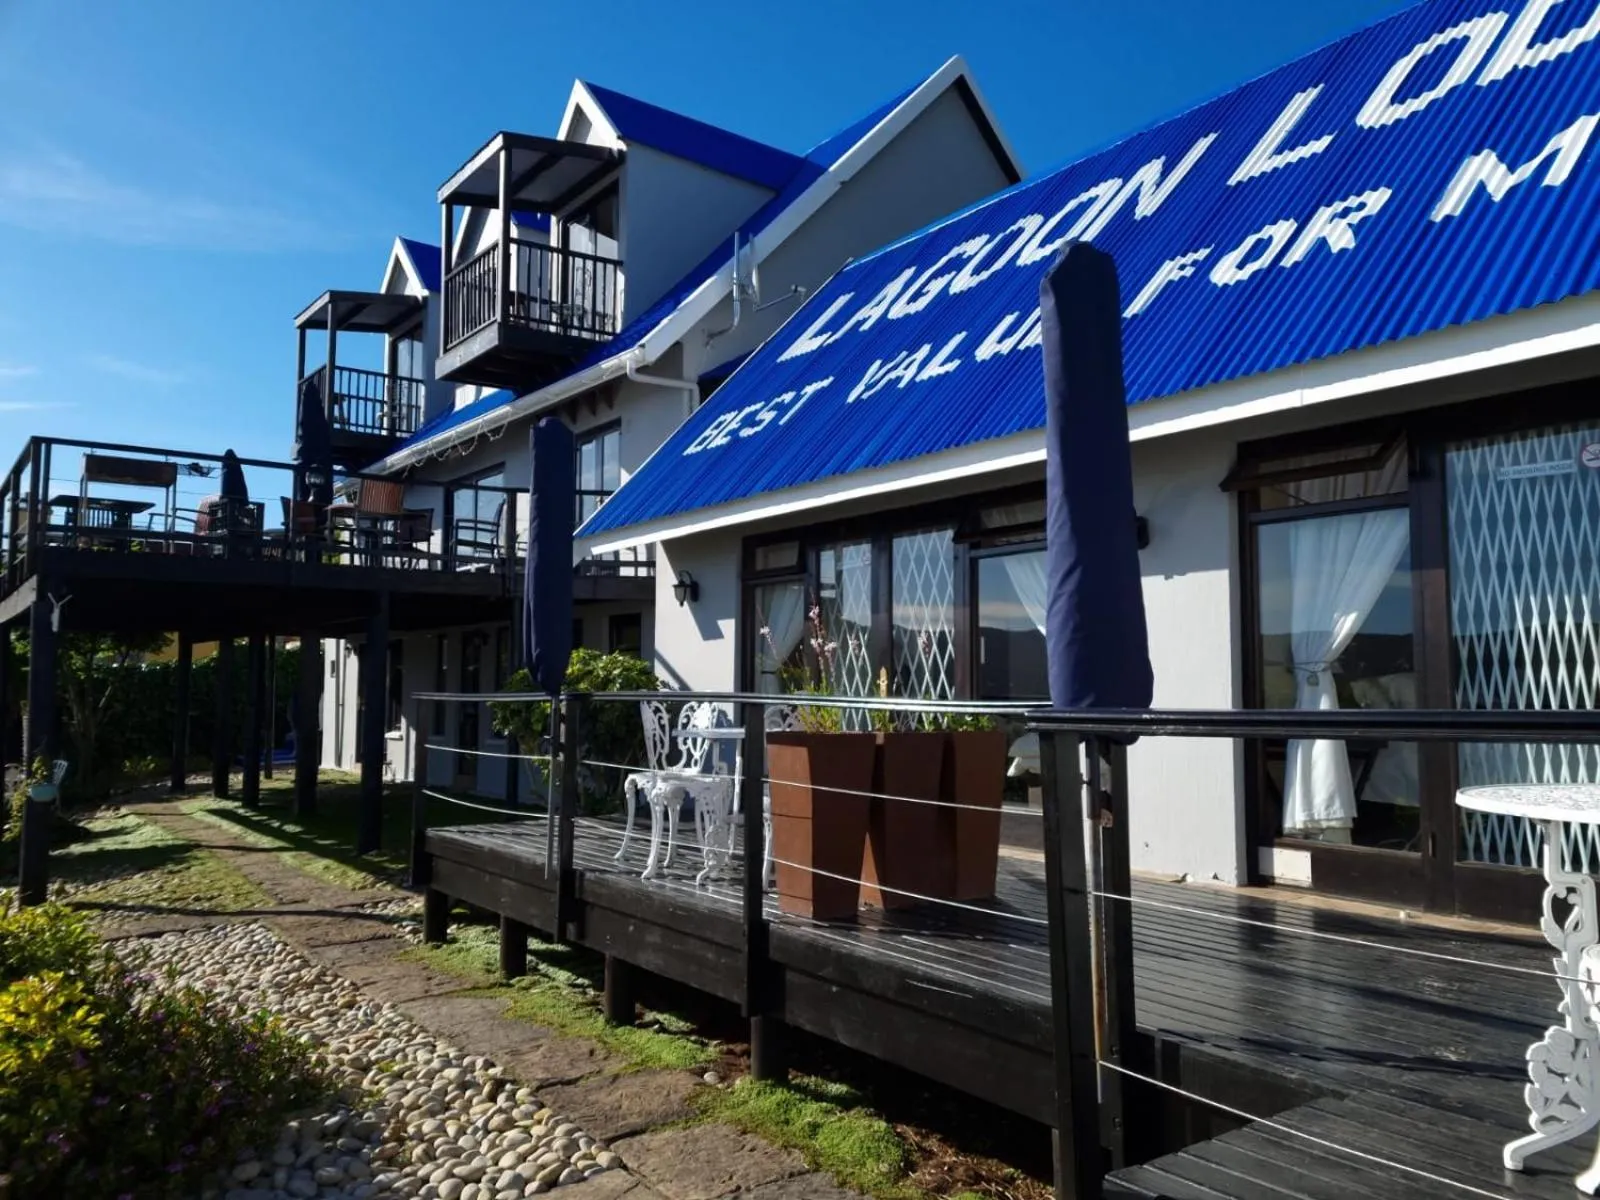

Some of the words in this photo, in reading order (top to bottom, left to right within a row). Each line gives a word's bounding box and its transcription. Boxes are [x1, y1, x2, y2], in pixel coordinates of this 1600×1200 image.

[682, 376, 834, 456] BEST
[1122, 187, 1392, 318] FOR
[777, 131, 1219, 363] LAGOON
